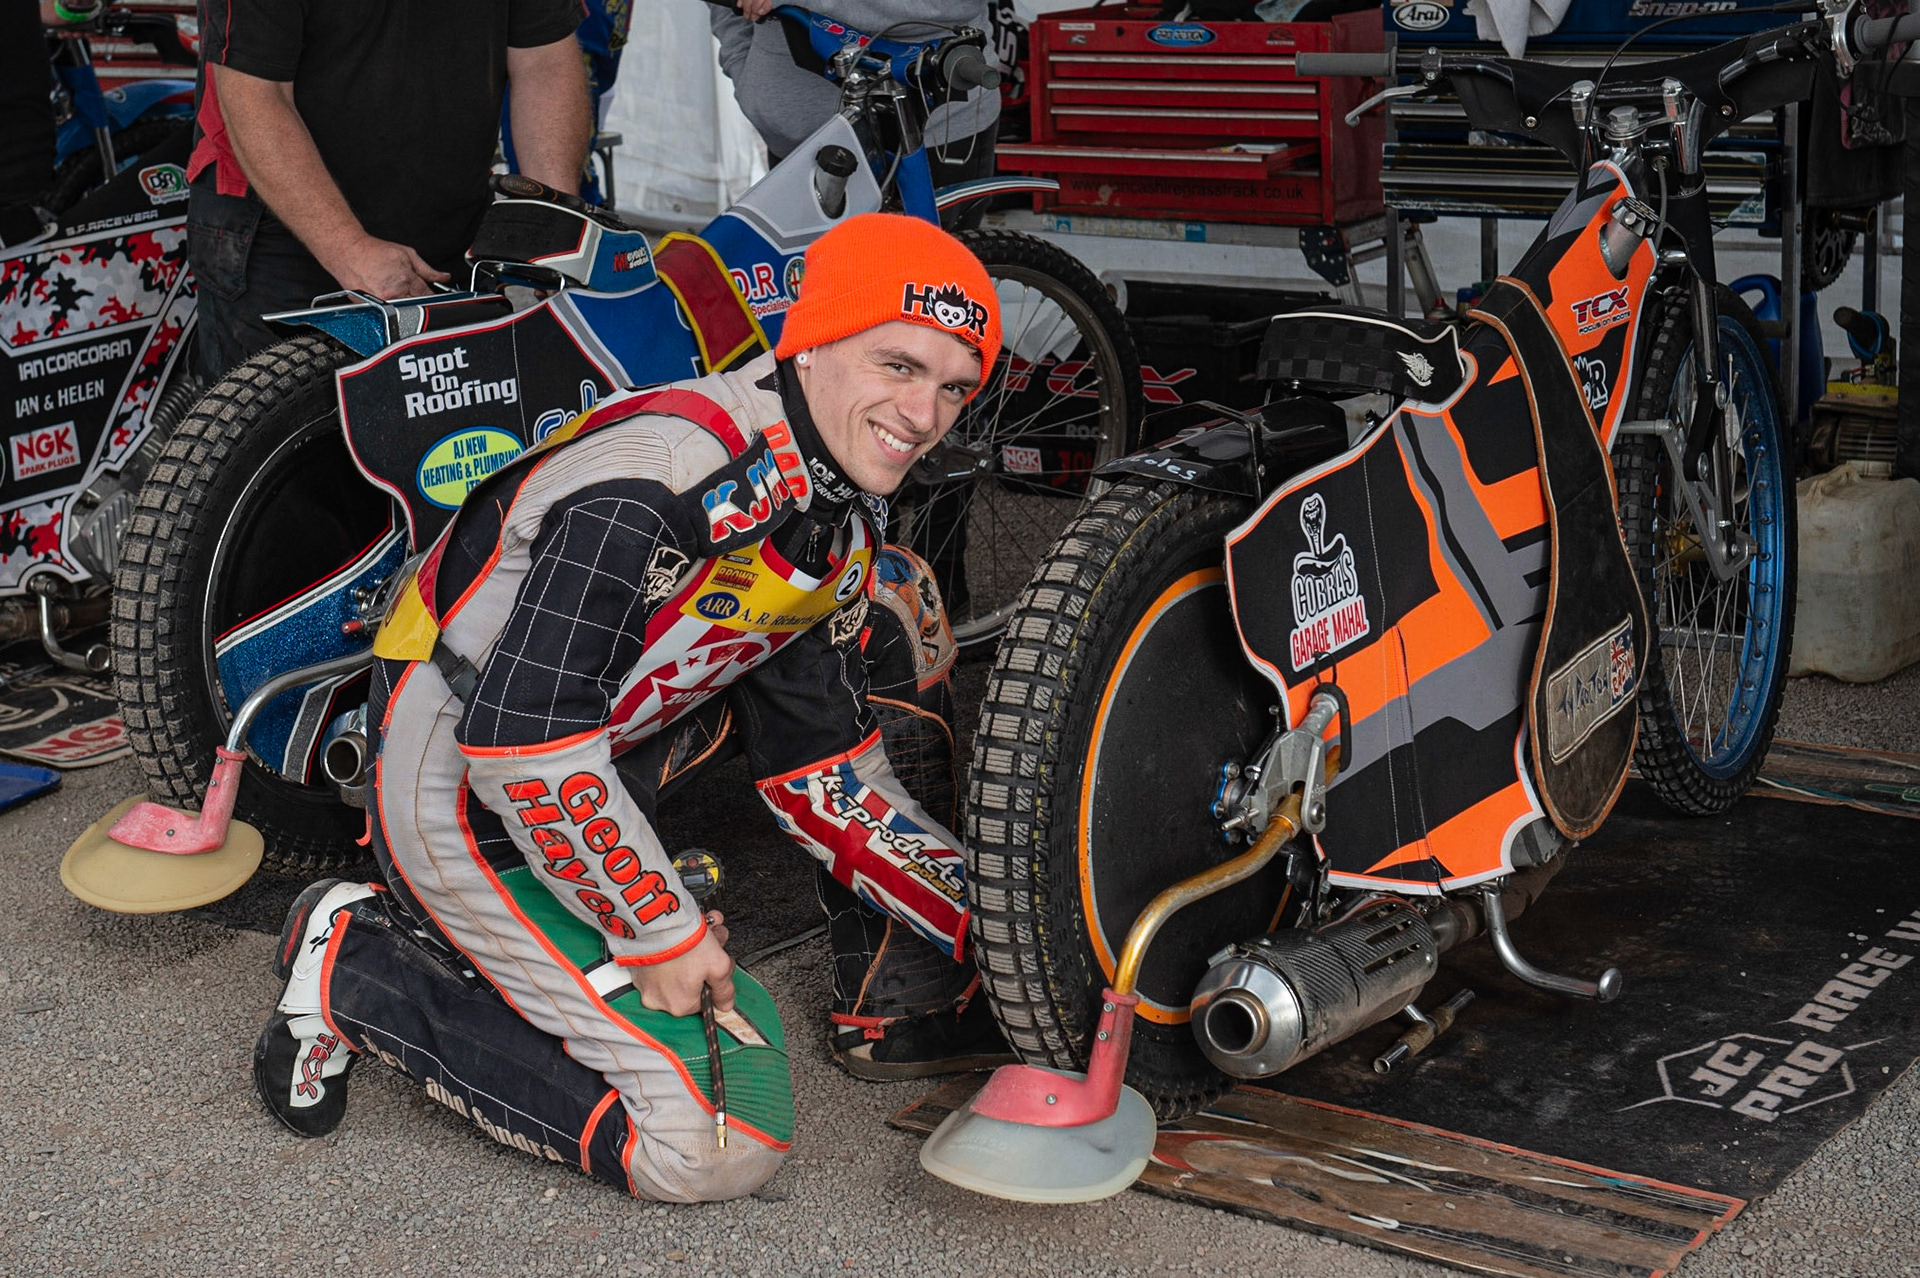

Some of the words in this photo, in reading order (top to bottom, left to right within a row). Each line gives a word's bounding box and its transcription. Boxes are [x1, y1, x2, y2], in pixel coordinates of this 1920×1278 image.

[1400, 5, 1441, 22] Arai
[1571, 286, 1630, 325] TCX
[18, 360, 45, 382] IAN
[46, 338, 132, 374] CORCORAN
[398, 347, 470, 383] Spot
[15, 395, 40, 419] IAN
[43, 394, 54, 412] &
[57, 379, 105, 408] HELEN
[404, 377, 518, 419] Roofing
[431, 374, 459, 394] On
[16, 426, 74, 466] NGK
[453, 440, 465, 460] AJ
[466, 434, 488, 456] NEW
[1003, 452, 1039, 467] NGK
[20, 463, 47, 477] SPARK
[47, 455, 76, 469] PLUGS
[423, 462, 463, 489] HEATING
[465, 463, 473, 478] &
[809, 457, 836, 485] JOE
[715, 566, 758, 587] BROWN
[839, 569, 859, 596] 2
[1293, 550, 1357, 623] COBRAS
[698, 597, 735, 617] ARR
[738, 607, 752, 622] A.
[756, 612, 770, 625] R.
[1292, 616, 1332, 668] GARAGE
[1331, 599, 1367, 646] MAHAL
[503, 778, 636, 940] Hayes
[558, 771, 681, 926] Geoff
[902, 861, 965, 901] poland
[1788, 946, 1915, 1032] RACE
[295, 1032, 340, 1100] TCX
[1730, 1040, 1845, 1122] PRO
